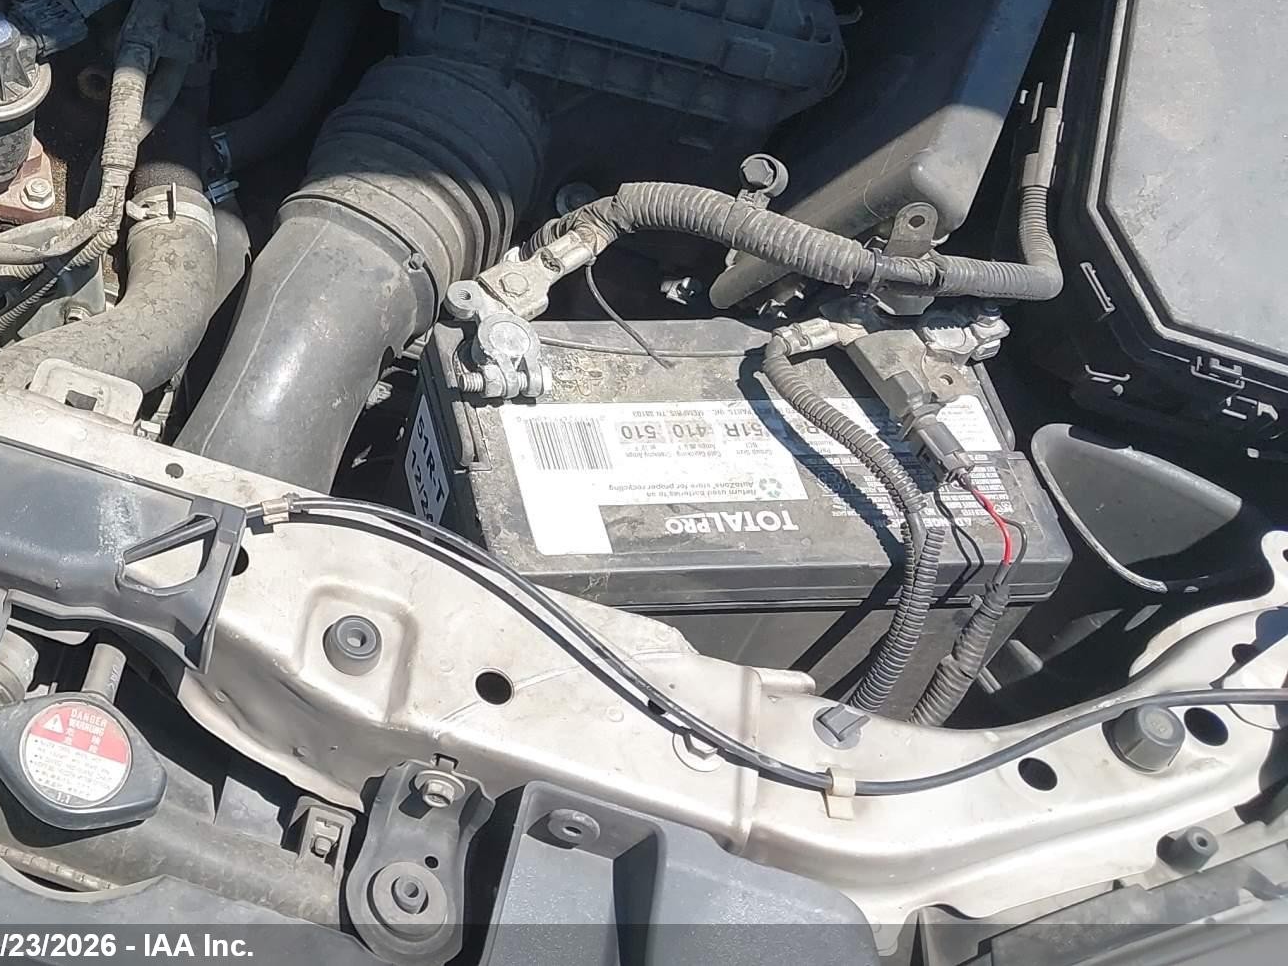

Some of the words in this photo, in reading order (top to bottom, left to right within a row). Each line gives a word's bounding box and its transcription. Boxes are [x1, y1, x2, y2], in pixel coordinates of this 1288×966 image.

[620, 425, 656, 440] 510
[672, 424, 707, 439] 410
[724, 422, 761, 437] 51R
[608, 482, 646, 492] recycling
[647, 482, 674, 491] proper
[676, 483, 688, 491] for
[707, 489, 726, 497] used
[663, 510, 799, 534] TOTALPRO
[71, 708, 108, 728] DANGER
[56, 792, 71, 805] 1.1
